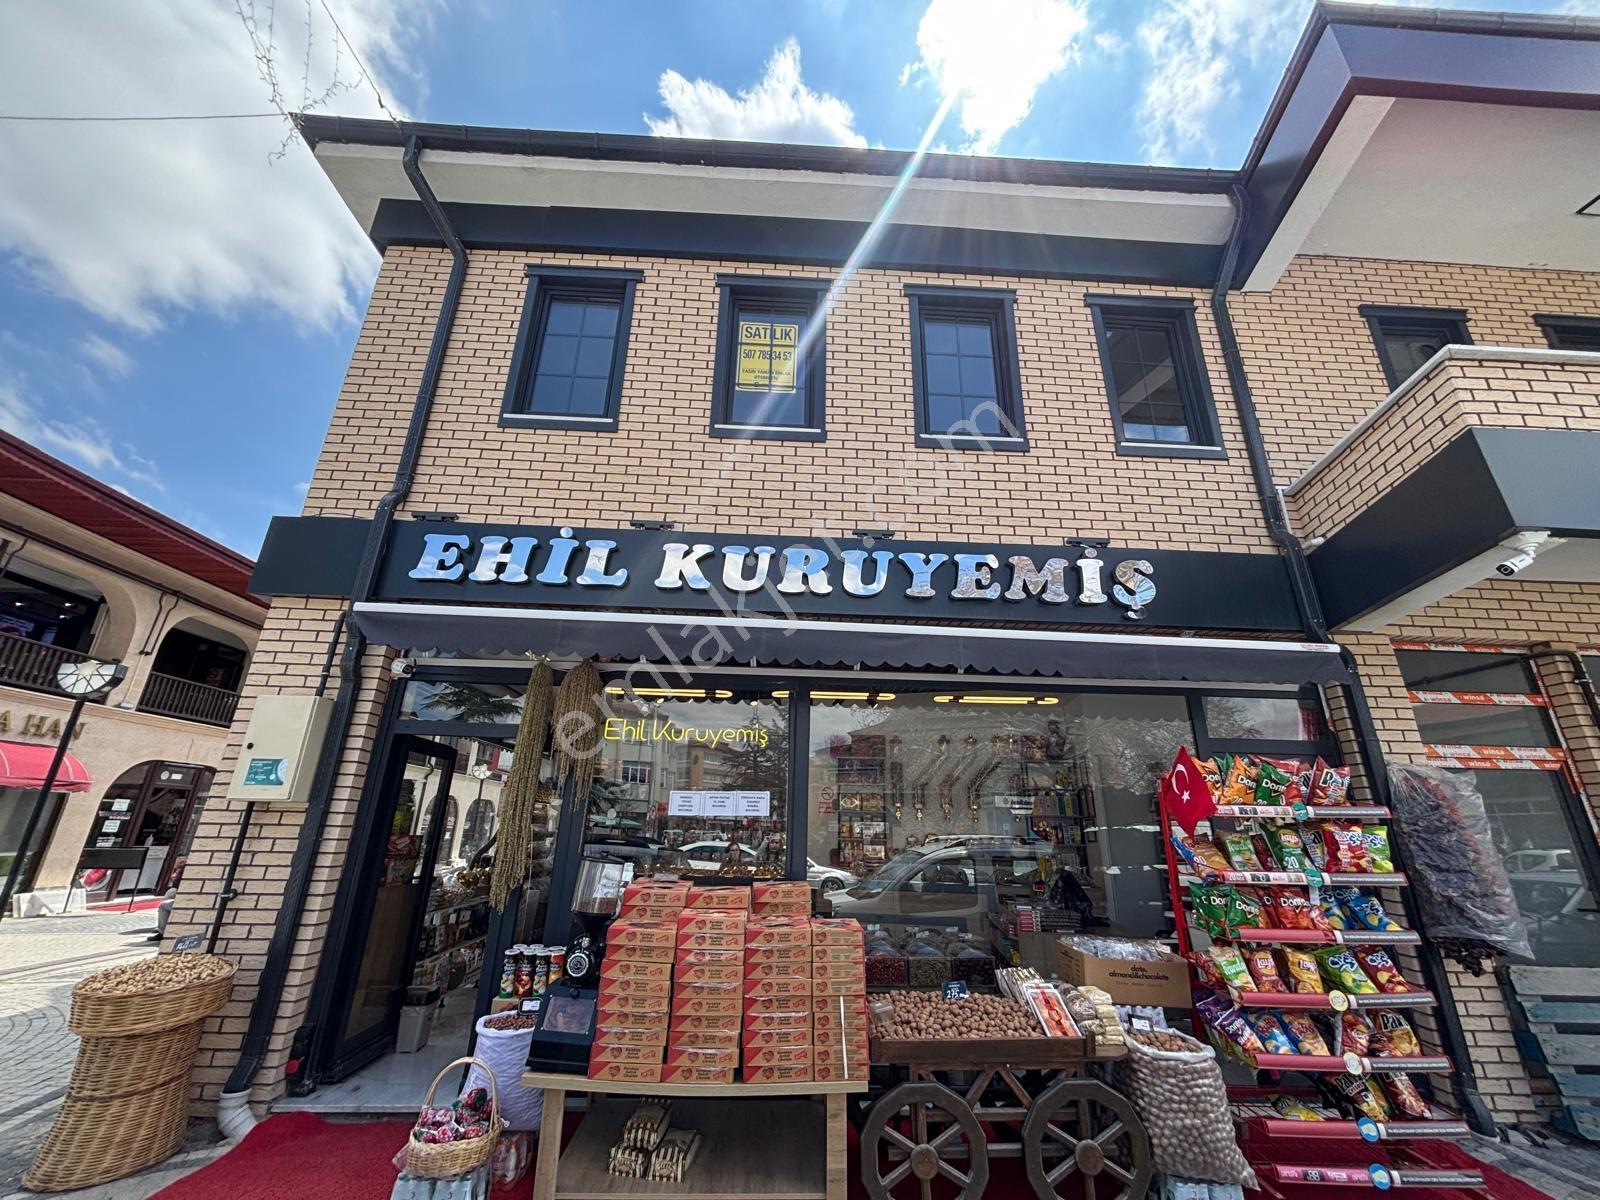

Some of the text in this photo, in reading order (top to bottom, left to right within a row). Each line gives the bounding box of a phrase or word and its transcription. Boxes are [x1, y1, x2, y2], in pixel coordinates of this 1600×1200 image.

[744, 326, 792, 341] SATLIK
[408, 527, 1157, 620] EHİL KURUYEMİŞ
[604, 717, 768, 749] Ehil Kuruyemiş
